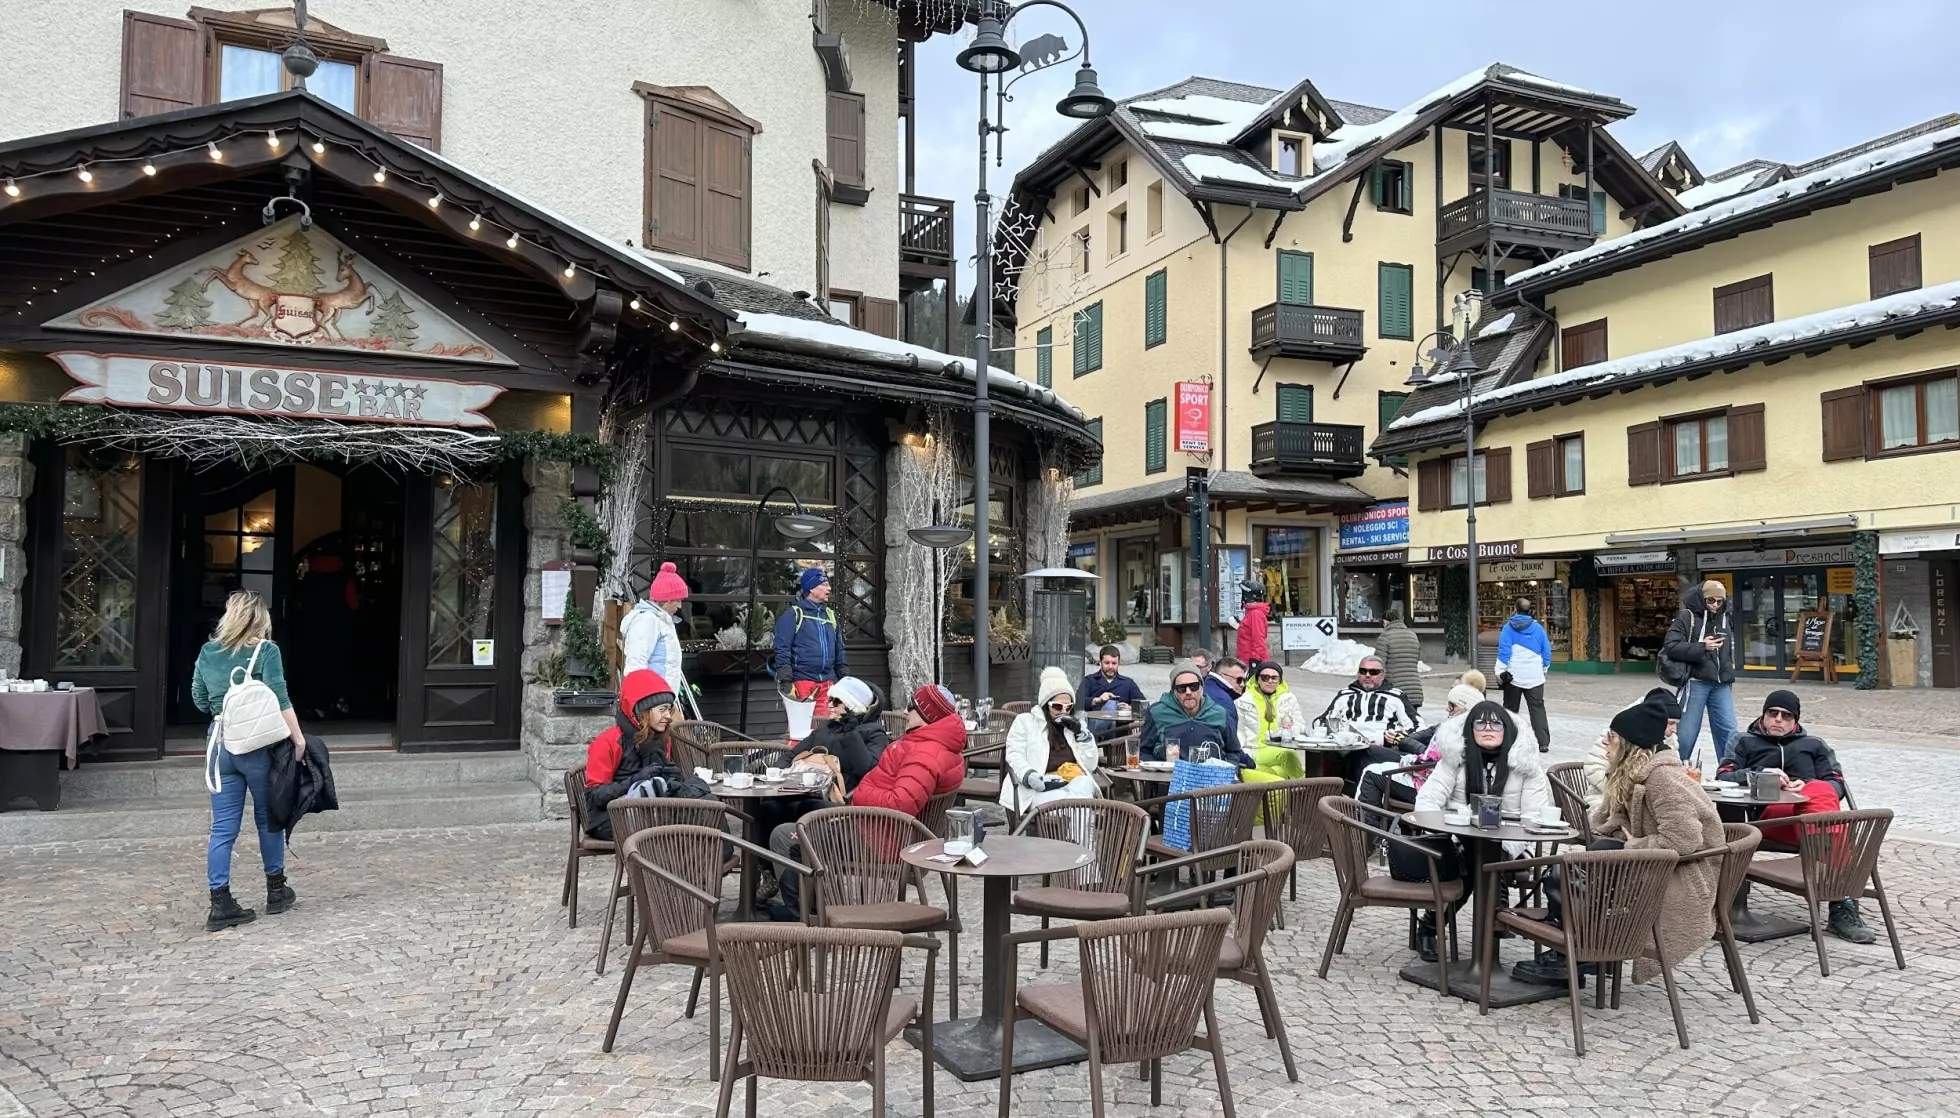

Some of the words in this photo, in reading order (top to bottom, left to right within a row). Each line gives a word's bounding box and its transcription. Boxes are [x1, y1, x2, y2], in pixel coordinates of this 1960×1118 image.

[277, 305, 314, 319] Suisse
[147, 361, 351, 415] SUISSE
[1180, 393, 1208, 406] SPORT
[358, 393, 425, 420] BAR
[1341, 510, 1386, 523] OLIMPIONICO
[1353, 523, 1386, 533] NOLEGGIO
[1387, 520, 1398, 530] SCI
[1341, 536, 1365, 546] RENTAL
[1370, 534, 1382, 543] SKI
[1336, 554, 1378, 563] OLIMPIONICO
[1381, 552, 1403, 560] SPORT
[1429, 548, 1443, 560] Le
[1446, 546, 1468, 559] Cos
[1478, 542, 1518, 557] Buone
[1785, 547, 1855, 563] Presanella
[1501, 563, 1518, 572] cose
[1936, 570, 1946, 636] LORENZI
